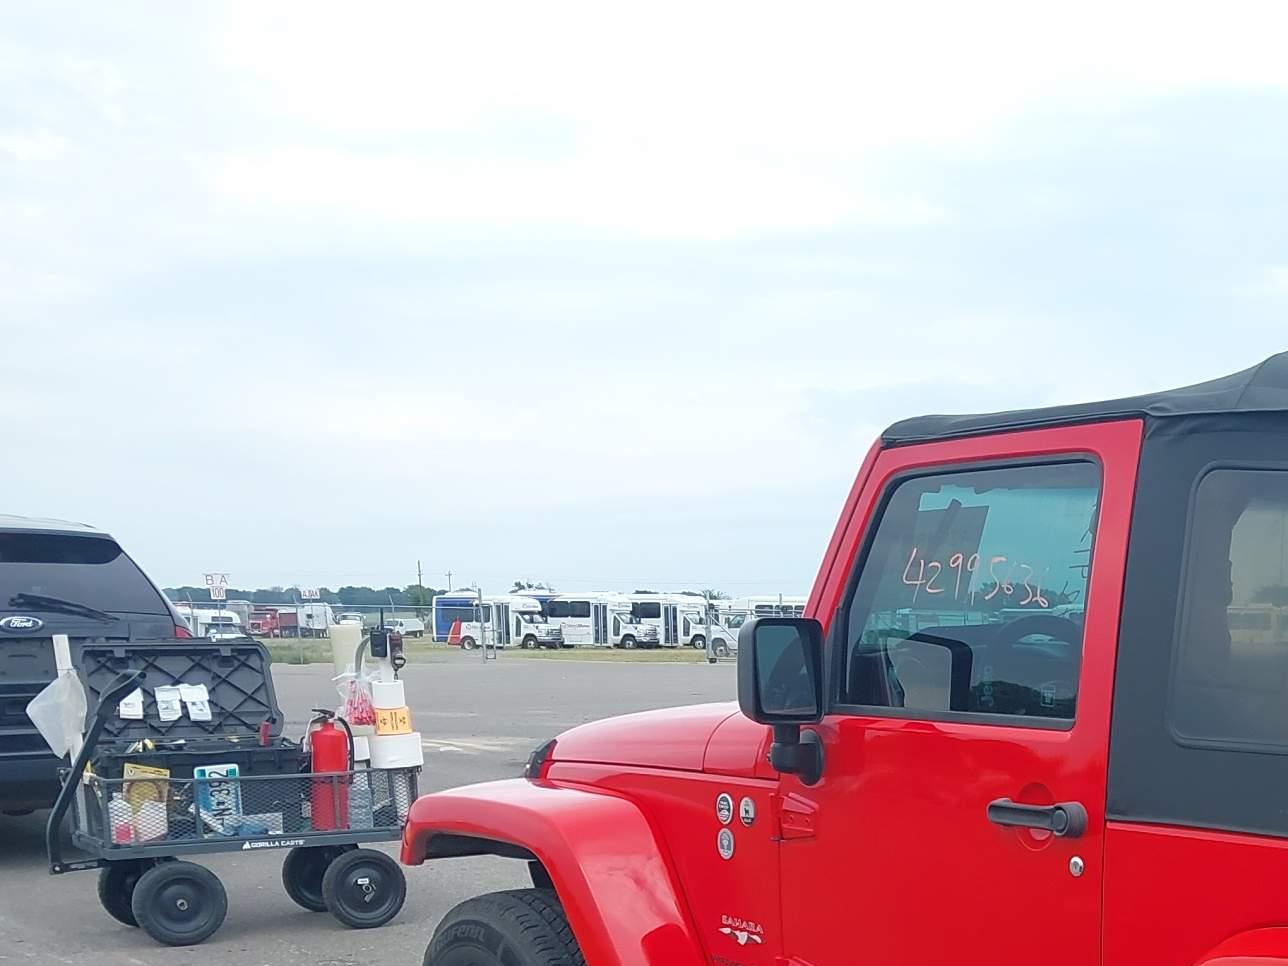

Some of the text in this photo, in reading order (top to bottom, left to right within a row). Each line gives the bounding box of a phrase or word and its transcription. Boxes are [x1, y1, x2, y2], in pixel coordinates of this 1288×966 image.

[902, 547, 1050, 608] 42995636
[10, 618, 33, 628] Ford
[721, 914, 764, 935] SAHARA
